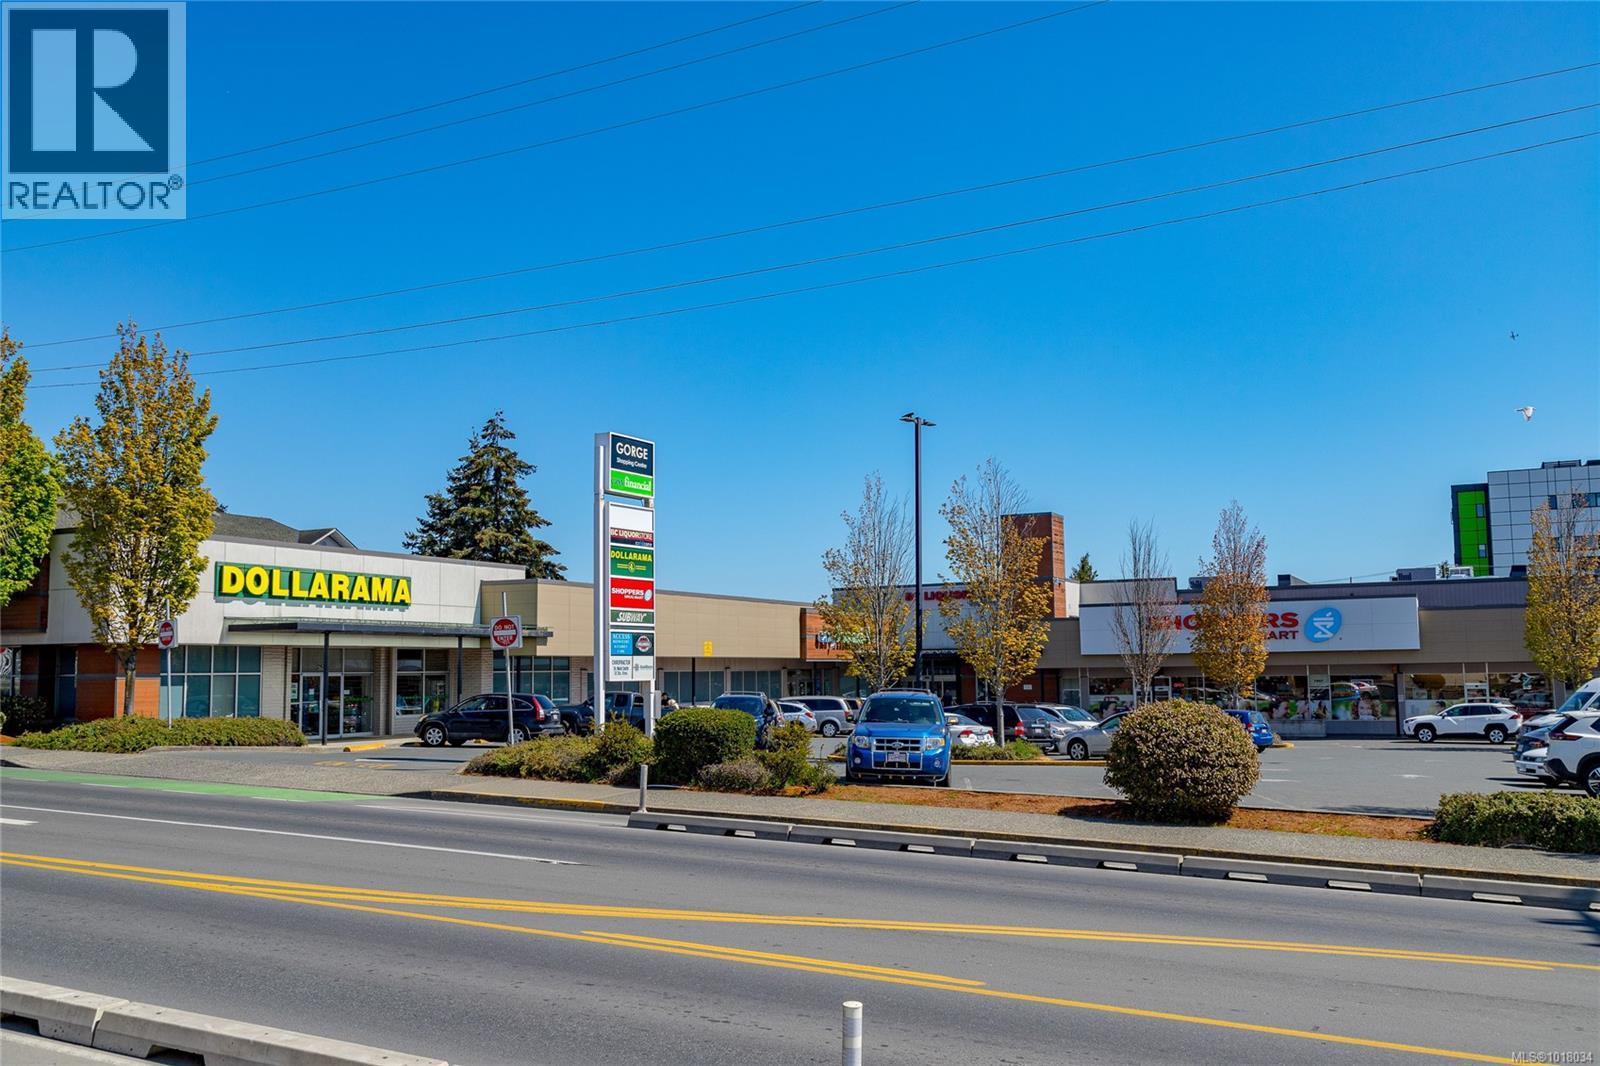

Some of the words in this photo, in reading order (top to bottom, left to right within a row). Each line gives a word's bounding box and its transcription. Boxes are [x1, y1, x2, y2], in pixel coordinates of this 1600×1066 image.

[616, 442, 648, 460] GORGE
[616, 457, 634, 467] Shopping
[611, 550, 653, 562] DOLLARAMA
[222, 565, 411, 604] DOLLARAMA
[611, 587, 644, 596] SHOPPERS
[616, 611, 647, 622] SUBWAY
[1149, 612, 1299, 631] SHORS
[1263, 630, 1298, 640] ART
